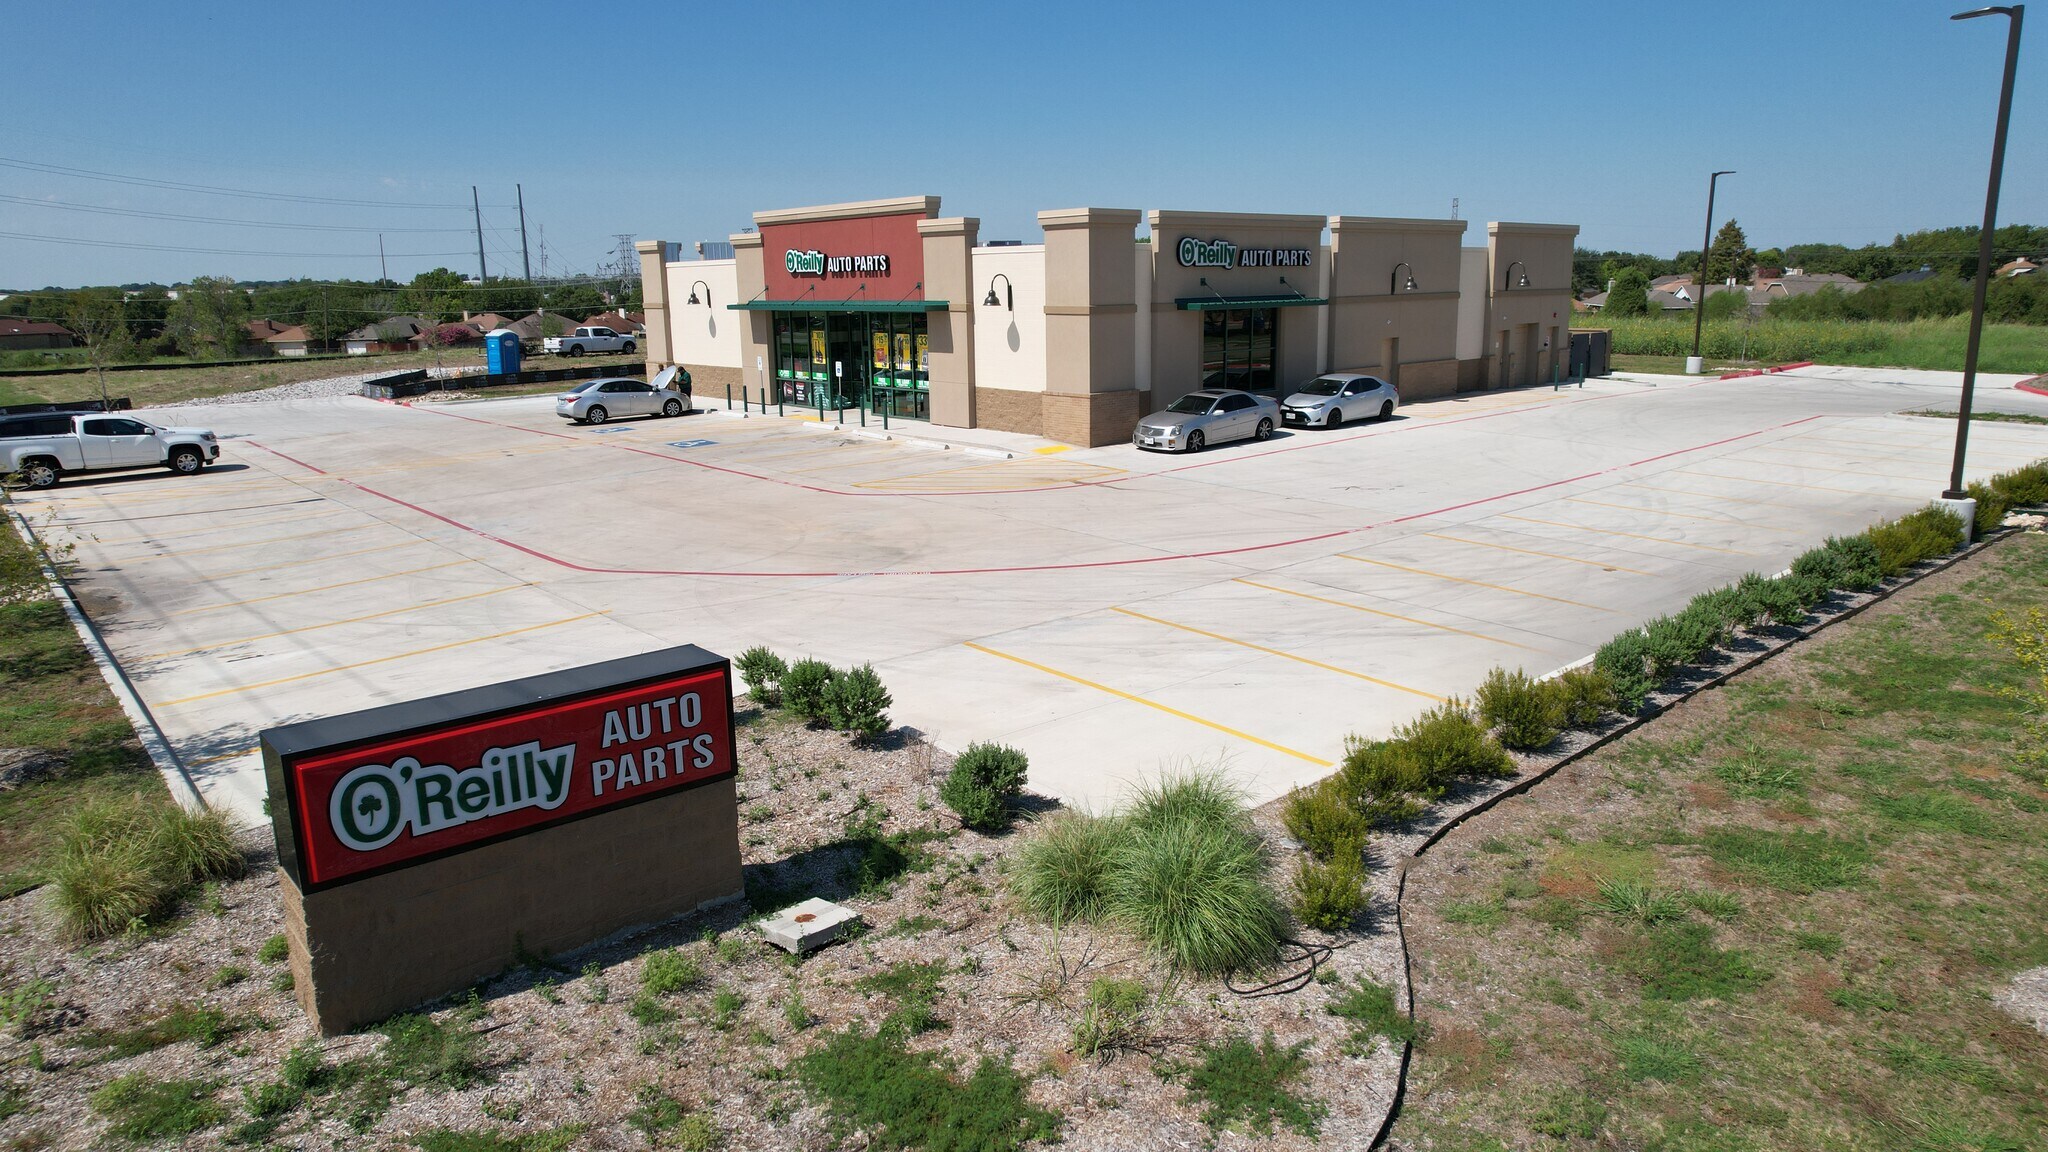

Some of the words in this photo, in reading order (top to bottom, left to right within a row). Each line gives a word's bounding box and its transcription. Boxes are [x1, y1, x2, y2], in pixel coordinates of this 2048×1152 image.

[786, 250, 824, 274] O'Reilly
[827, 257, 852, 272] AUTO
[854, 255, 887, 271] PARTS
[1181, 238, 1237, 268] O'Reilly
[1242, 250, 1273, 267] AUTO
[1276, 250, 1312, 266] PARTS
[602, 691, 703, 749] AUTO
[336, 748, 570, 846] O'Reilly
[592, 733, 715, 797] PARTS
